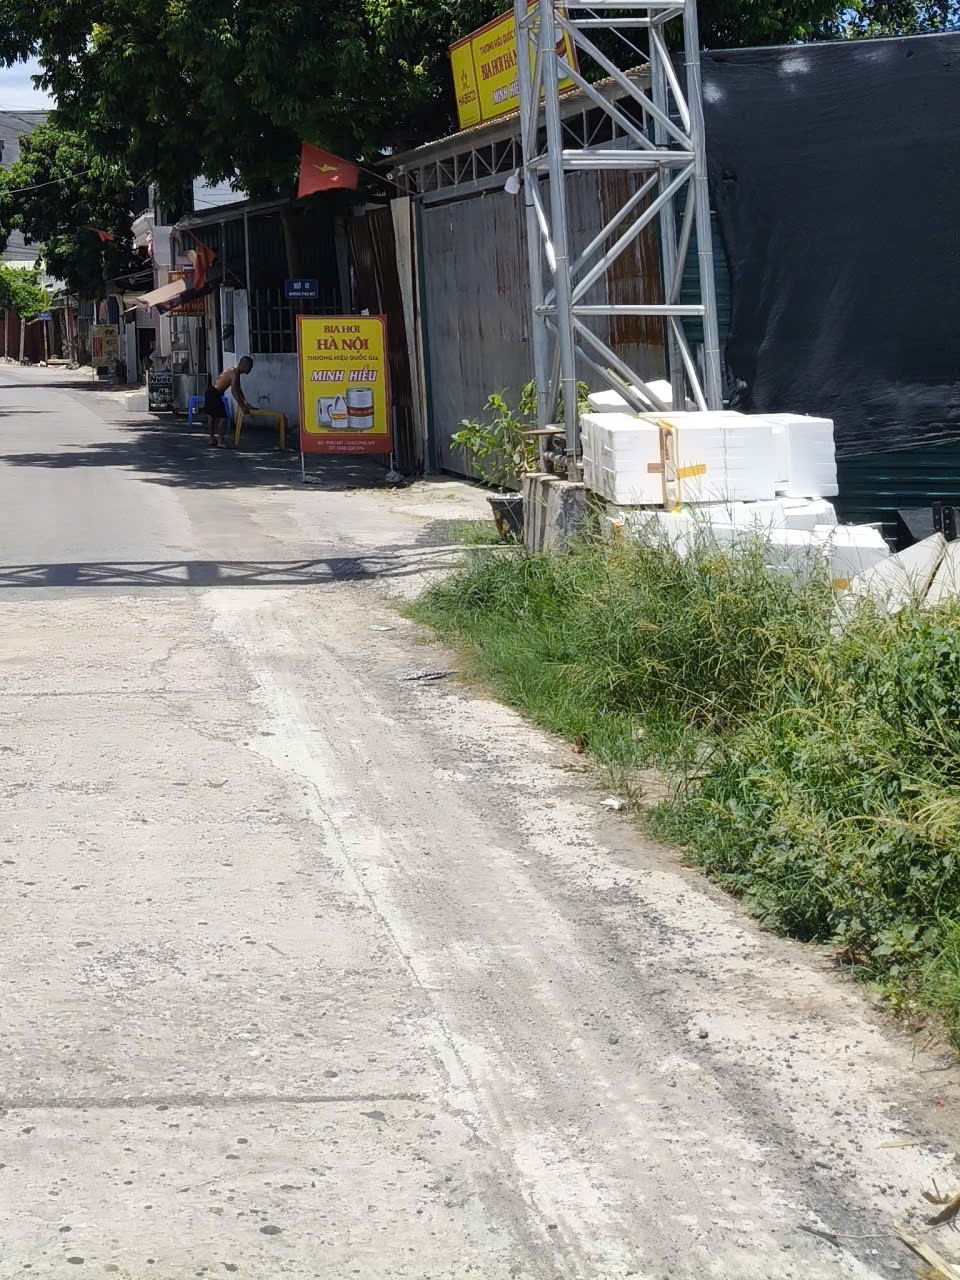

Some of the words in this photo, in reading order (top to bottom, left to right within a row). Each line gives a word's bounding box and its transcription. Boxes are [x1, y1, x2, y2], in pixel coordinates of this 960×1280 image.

[324, 325, 340, 333] BIA
[342, 325, 361, 333] HƠI
[317, 335, 340, 350] HÀ
[342, 335, 370, 353] NỘI
[310, 369, 345, 382] MINH
